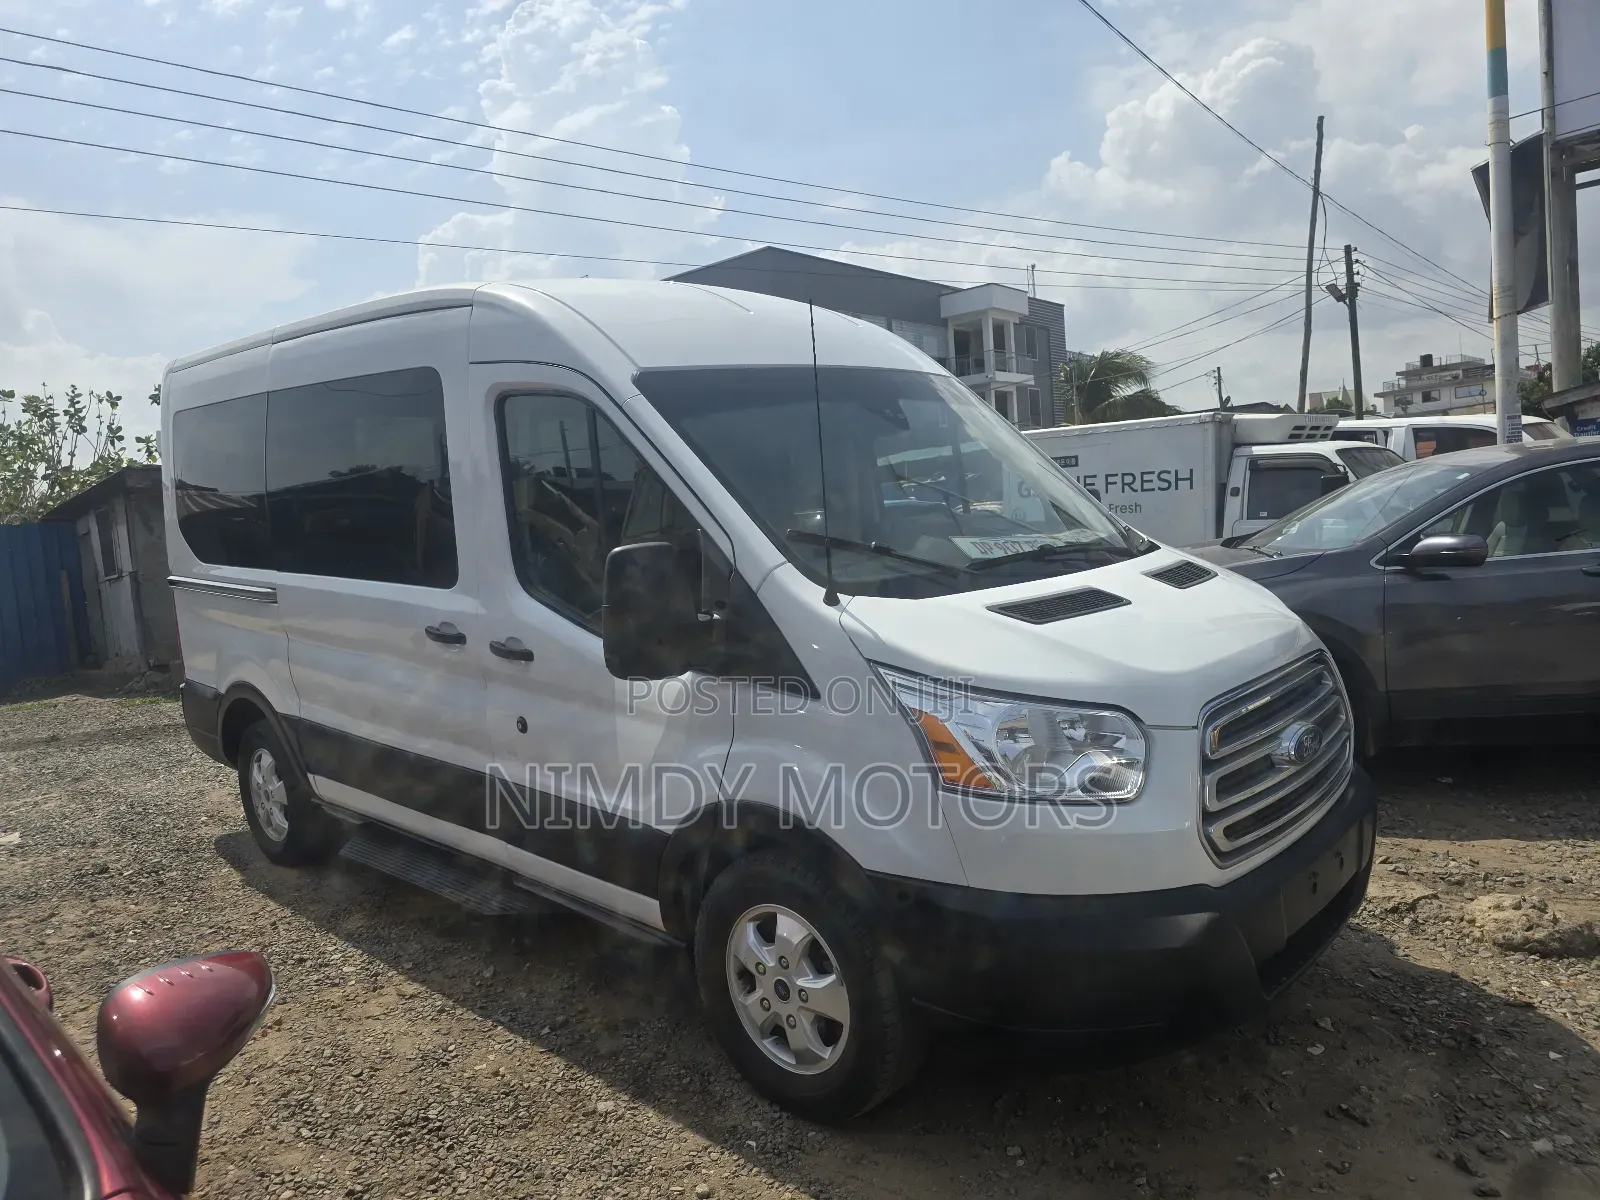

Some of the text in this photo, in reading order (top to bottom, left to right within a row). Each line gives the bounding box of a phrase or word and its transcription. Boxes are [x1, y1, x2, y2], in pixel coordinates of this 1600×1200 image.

[1576, 424, 1597, 432] Credit
[1104, 468, 1195, 495] FRESH
[1108, 502, 1142, 514] Fresh
